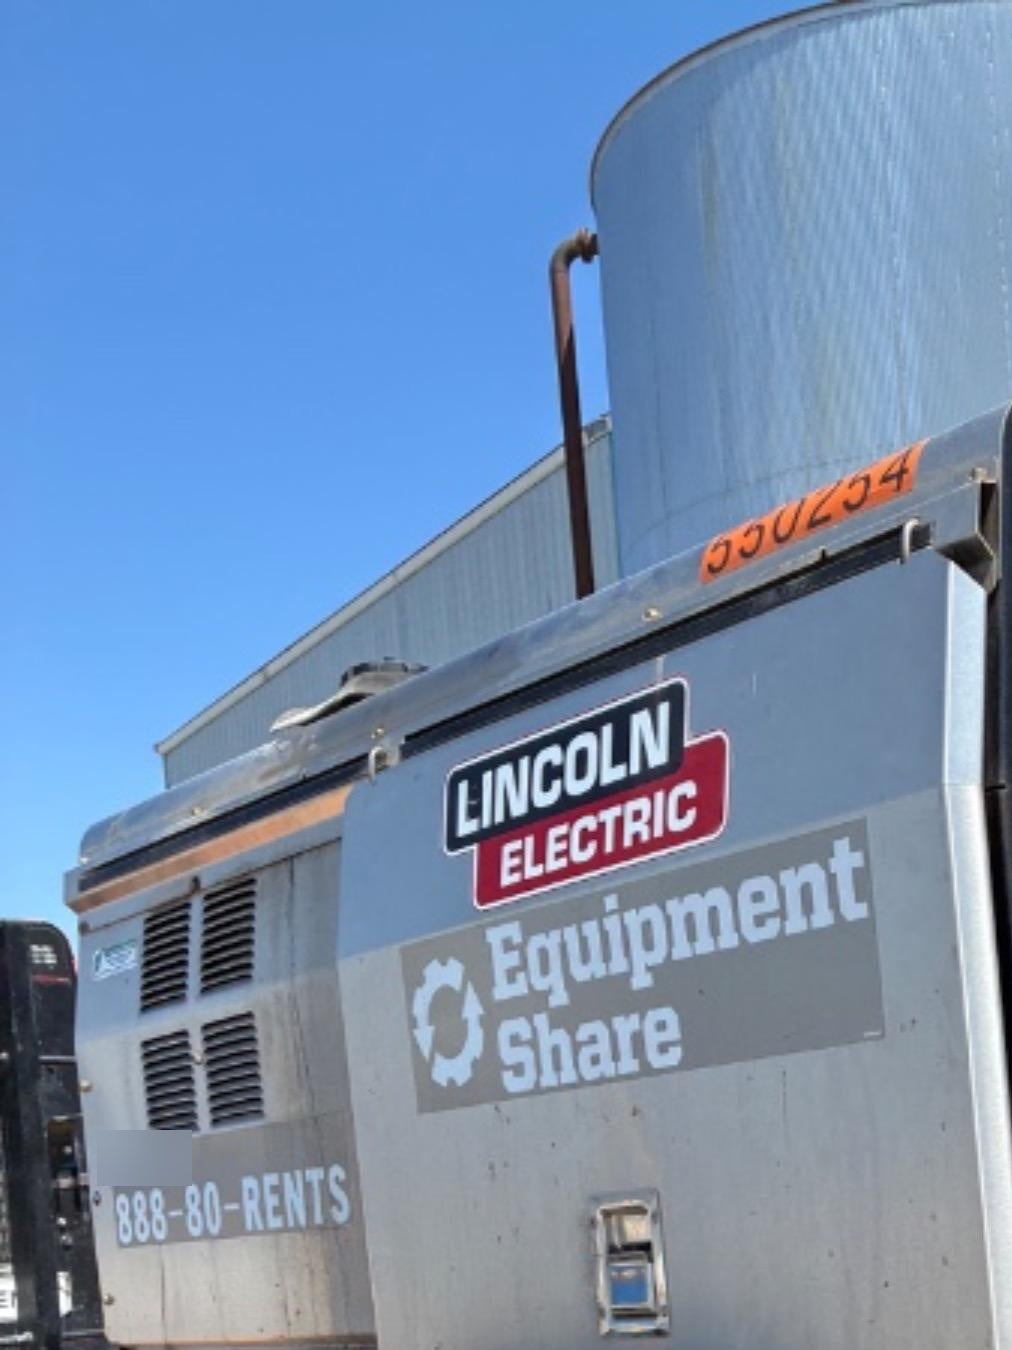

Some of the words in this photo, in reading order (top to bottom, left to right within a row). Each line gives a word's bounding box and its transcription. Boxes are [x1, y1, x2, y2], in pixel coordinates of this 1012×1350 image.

[455, 701, 671, 838] LINCOLN
[500, 779, 698, 888] ELECTRIC
[485, 836, 868, 1008] Equipment
[498, 1006, 683, 1094] Share
[115, 1163, 350, 1245] 888-80-RENTS
